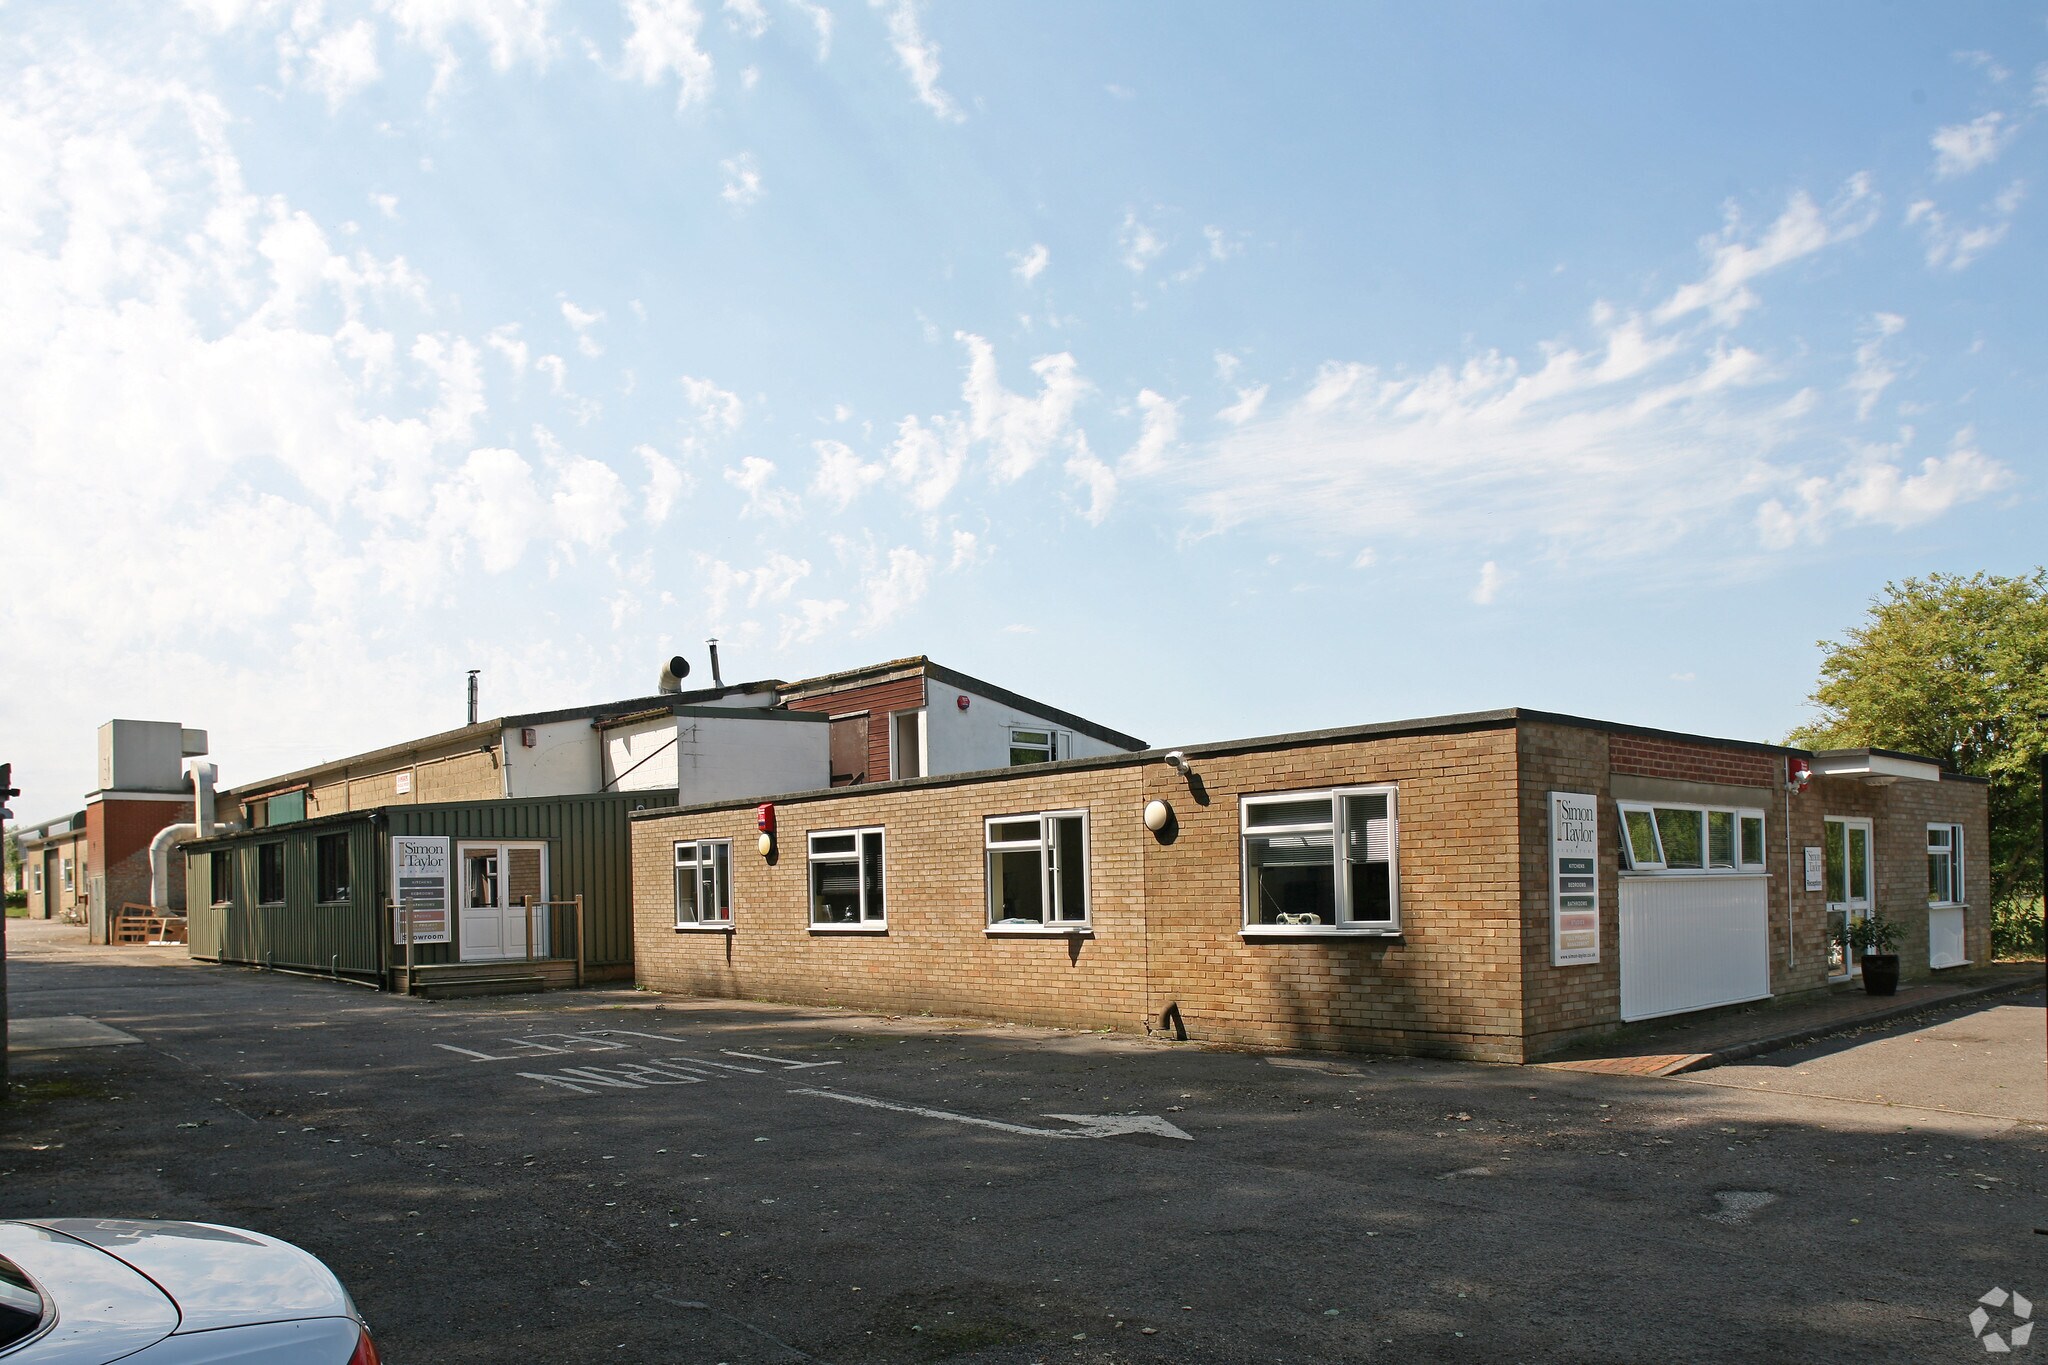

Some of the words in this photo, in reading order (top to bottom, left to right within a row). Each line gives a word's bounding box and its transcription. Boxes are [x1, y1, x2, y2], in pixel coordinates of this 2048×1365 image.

[1561, 799, 1594, 822] Simon
[1561, 821, 1594, 849] Taylor
[404, 841, 444, 854] Simon
[404, 854, 444, 871] Taylor
